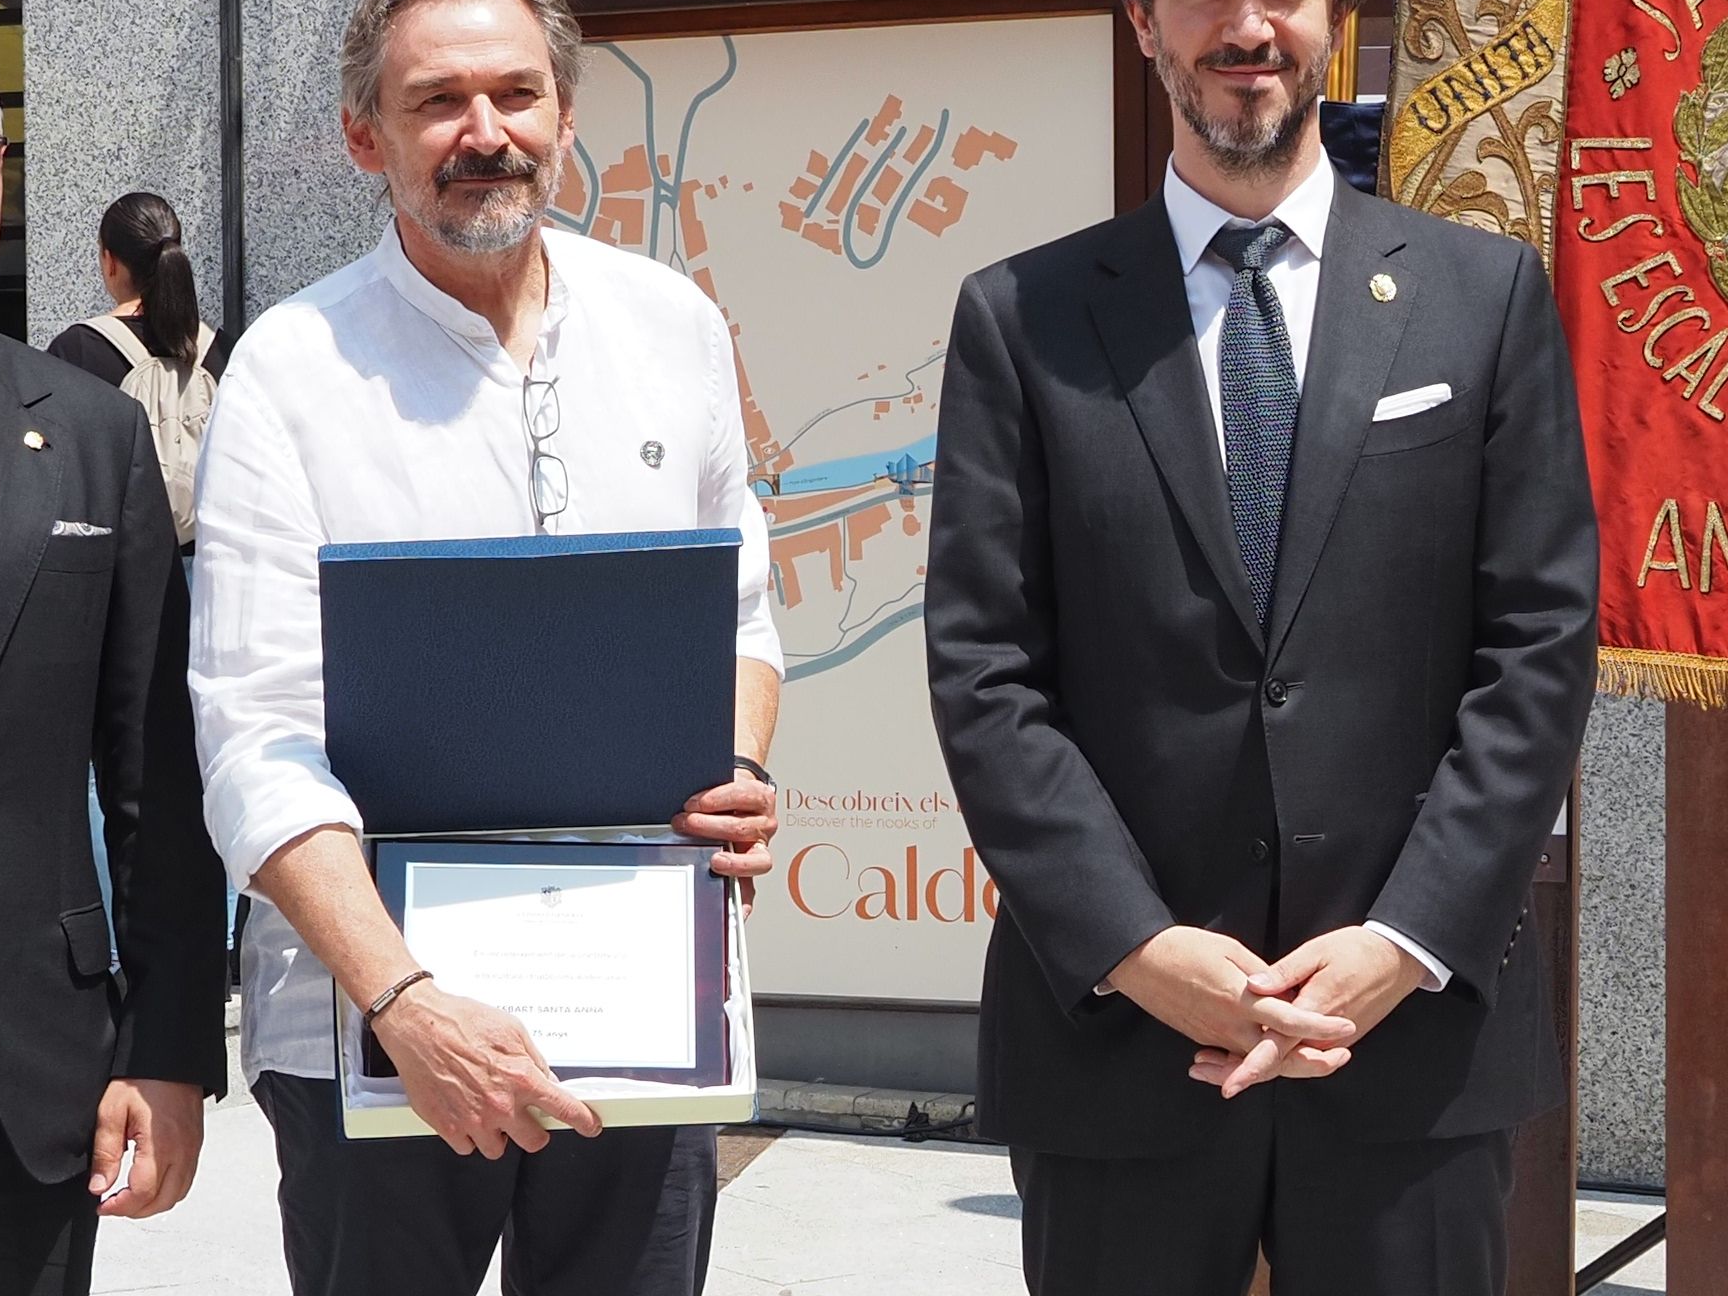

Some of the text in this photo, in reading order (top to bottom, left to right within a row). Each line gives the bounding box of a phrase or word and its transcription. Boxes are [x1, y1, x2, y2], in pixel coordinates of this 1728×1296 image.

[1569, 136, 1665, 243] LES
[785, 788, 914, 813] Descobreix
[919, 791, 950, 814] els
[785, 814, 939, 831] Discover the nooks of
